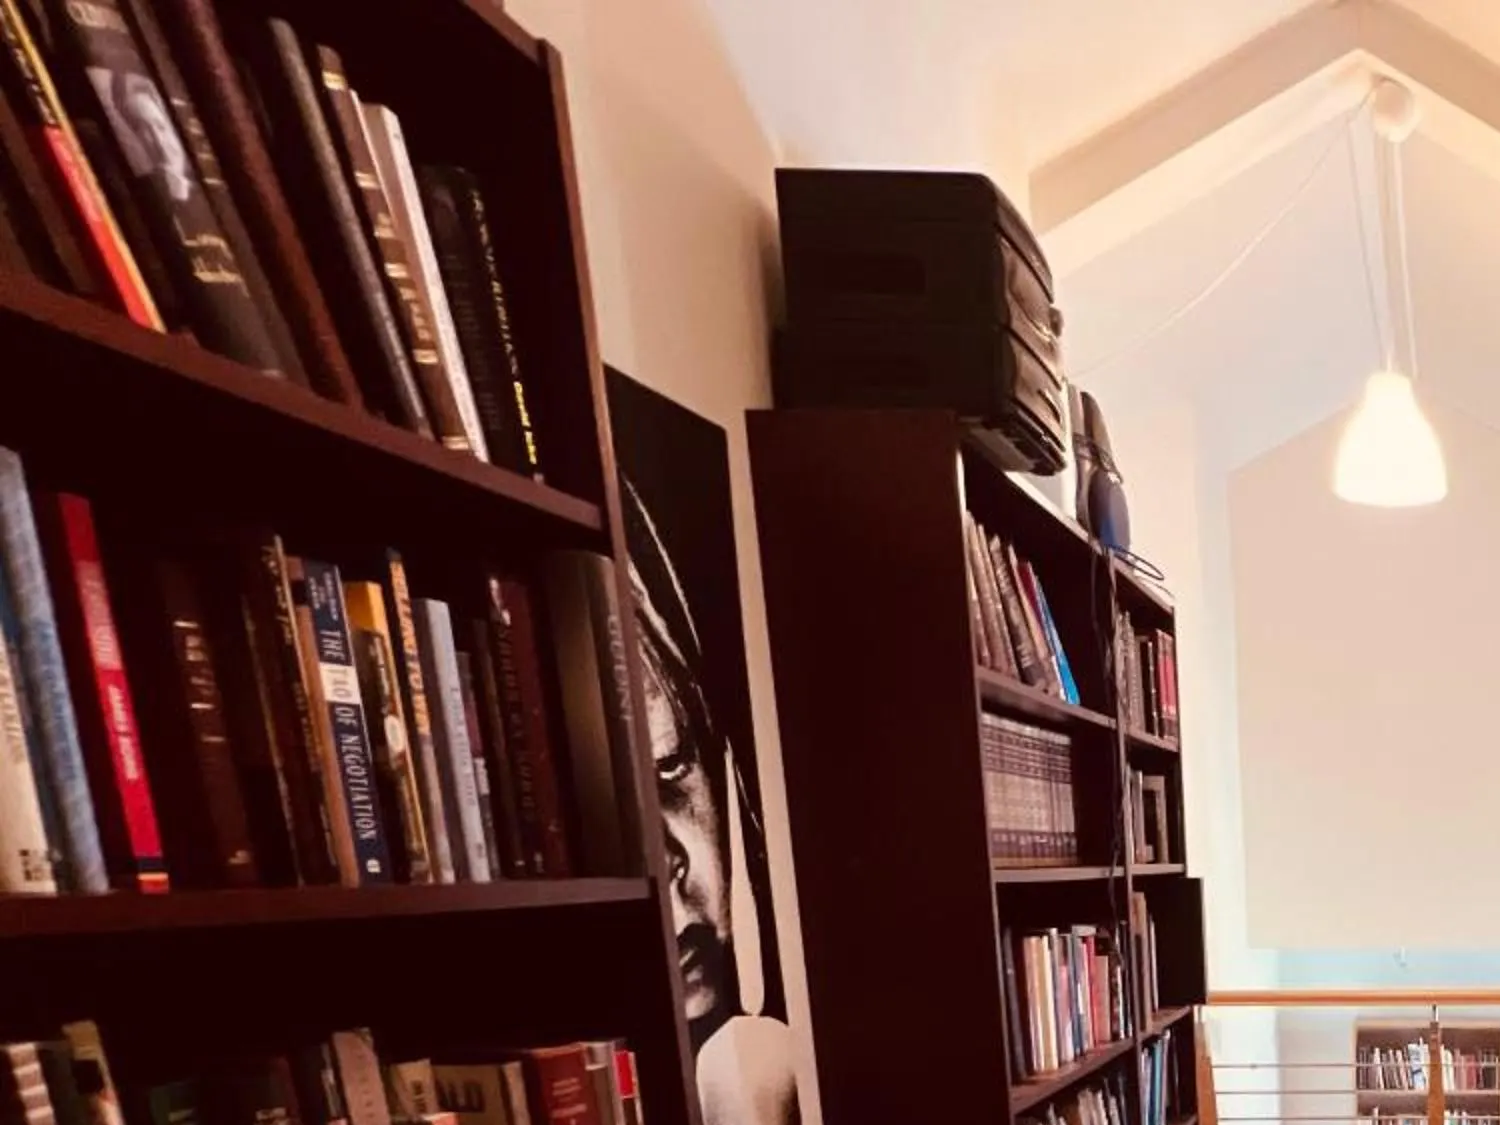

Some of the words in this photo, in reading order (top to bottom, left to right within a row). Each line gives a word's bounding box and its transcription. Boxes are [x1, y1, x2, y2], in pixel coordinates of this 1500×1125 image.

[319, 628, 346, 659] THE
[335, 703, 359, 728] OF
[340, 734, 380, 841] NEGOTIATION
